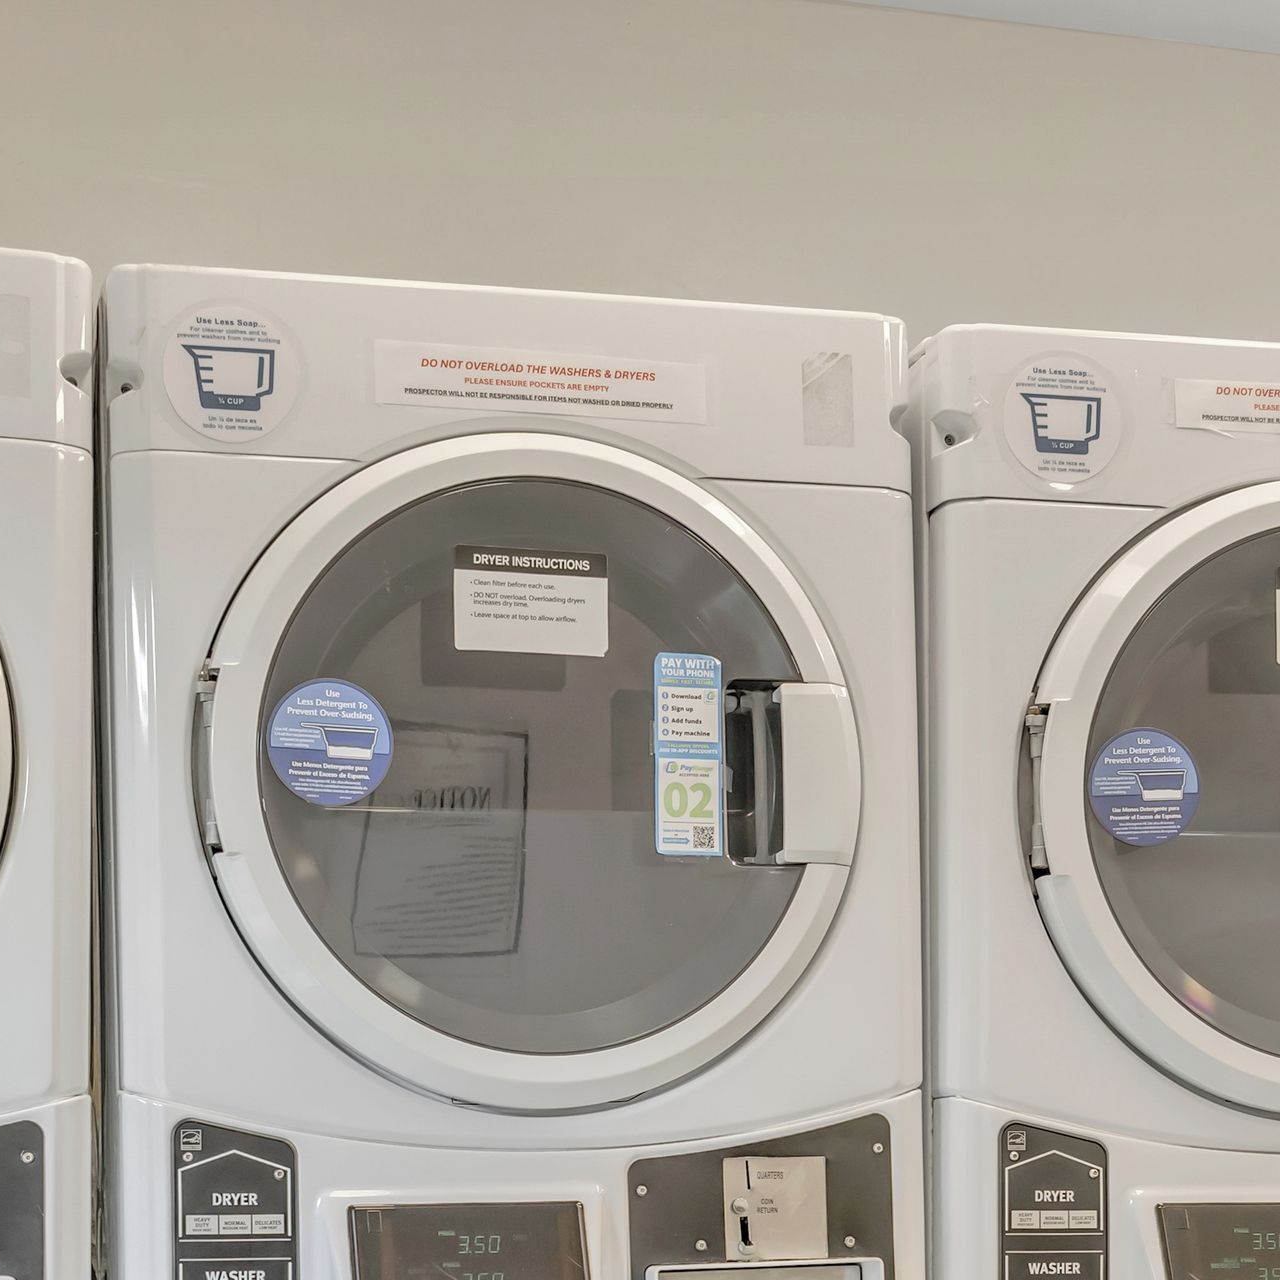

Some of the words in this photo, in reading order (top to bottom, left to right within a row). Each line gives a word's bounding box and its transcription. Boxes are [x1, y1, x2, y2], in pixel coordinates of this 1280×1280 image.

[196, 317, 212, 325] Use
[215, 318, 234, 326] Less
[421, 358, 438, 368] DO
[440, 359, 463, 370] NOT
[465, 361, 523, 374] OVERLOAD
[526, 364, 547, 375] THE
[549, 366, 602, 378] WASHERS
[604, 370, 611, 379] &
[614, 370, 656, 382] DRYERS
[464, 377, 494, 386] PLEASE
[496, 379, 527, 388] ENSURE
[529, 380, 566, 390] POCKETS
[567, 383, 582, 391] ARE
[584, 384, 609, 393] EMPTY
[1216, 386, 1230, 395] DO
[1233, 387, 1253, 397] NOT
[404, 388, 447, 397] PROSPECTOR
[489, 392, 533, 401] RESPONSIBLE
[582, 397, 610, 406] WASHED
[621, 400, 641, 408] DRIED
[642, 401, 674, 410] PROPERLY
[473, 554, 509, 566] DRYER
[512, 556, 590, 571] INSTRUCTIONS
[529, 595, 566, 604] Overloading
[567, 597, 585, 605] dryers
[661, 658, 683, 668] PAY
[685, 659, 714, 669] WITH
[661, 668, 685, 677] YOUR
[686, 669, 714, 678] PHONE
[326, 689, 340, 698] Use
[297, 698, 314, 706] Less
[316, 699, 356, 710] Detergent
[671, 705, 685, 713] Sign
[287, 707, 318, 716] Prevent
[663, 782, 714, 818] 02
[757, 1171, 783, 1179] QUARTERS
[212, 1192, 258, 1206] DRYER
[1035, 1190, 1075, 1202] DRYER
[458, 1236, 501, 1254] 3.50
[1028, 1262, 1081, 1274] WASHER
